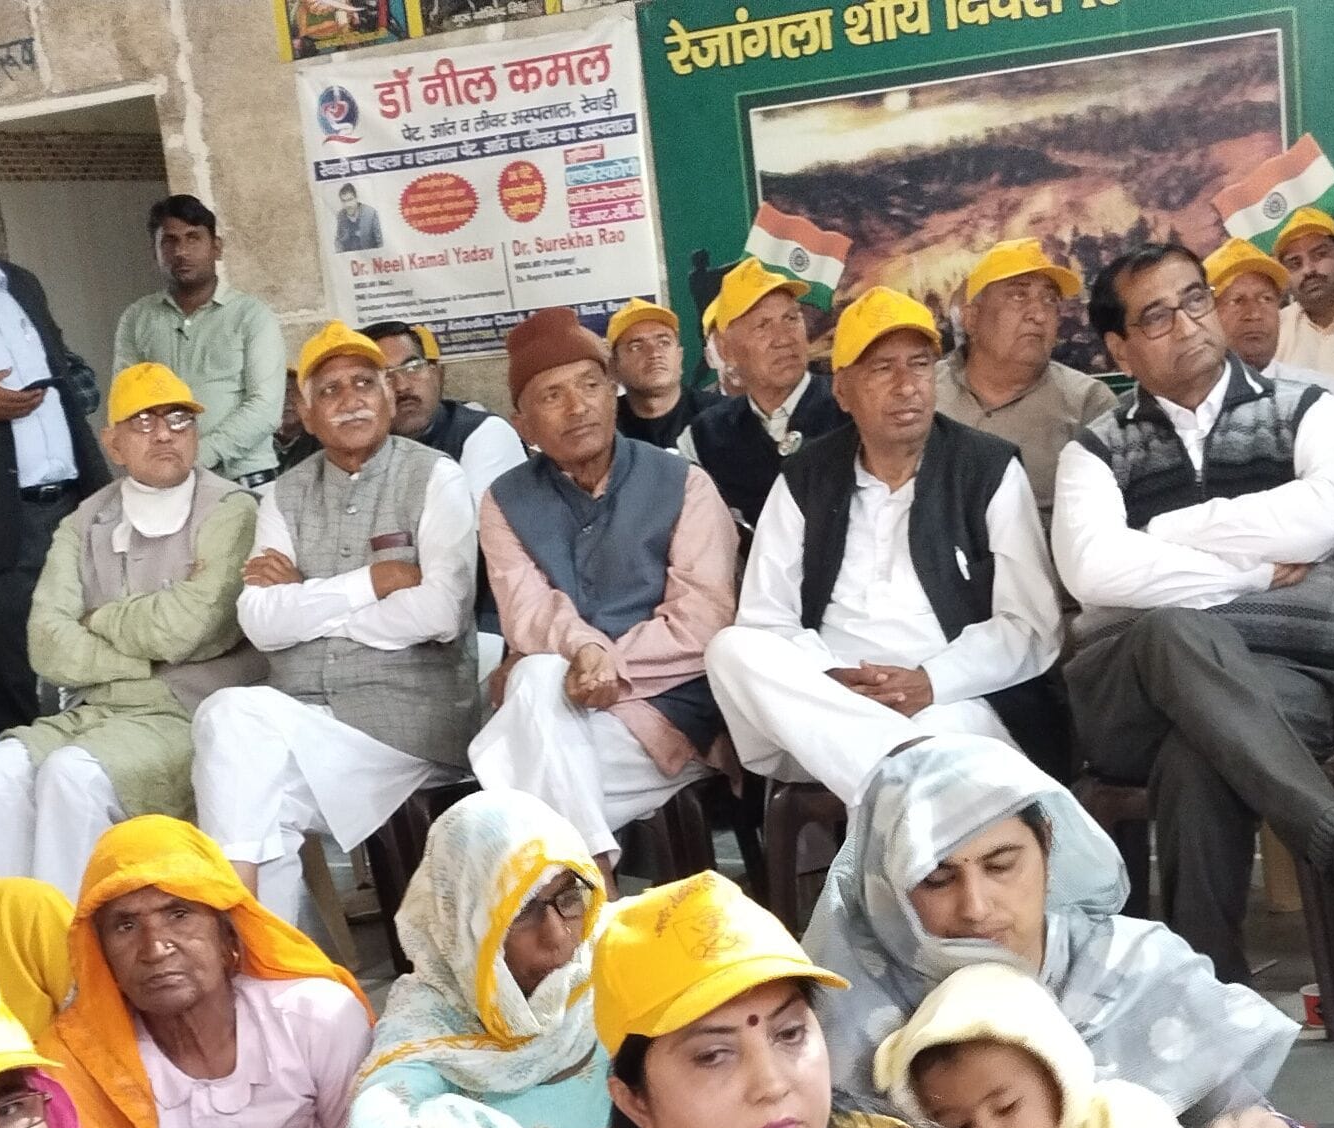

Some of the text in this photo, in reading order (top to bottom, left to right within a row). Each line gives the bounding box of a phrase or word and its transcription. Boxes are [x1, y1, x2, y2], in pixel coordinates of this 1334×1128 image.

[664, 7, 834, 75] रेजांगला
[374, 44, 613, 119] डॉ नील कमल
[351, 259, 369, 277] Dr.
[372, 254, 405, 275] Neel
[407, 249, 450, 269] Kamal
[452, 245, 495, 264] Yadav
[512, 228, 626, 257] Dr. Surekha Rao
